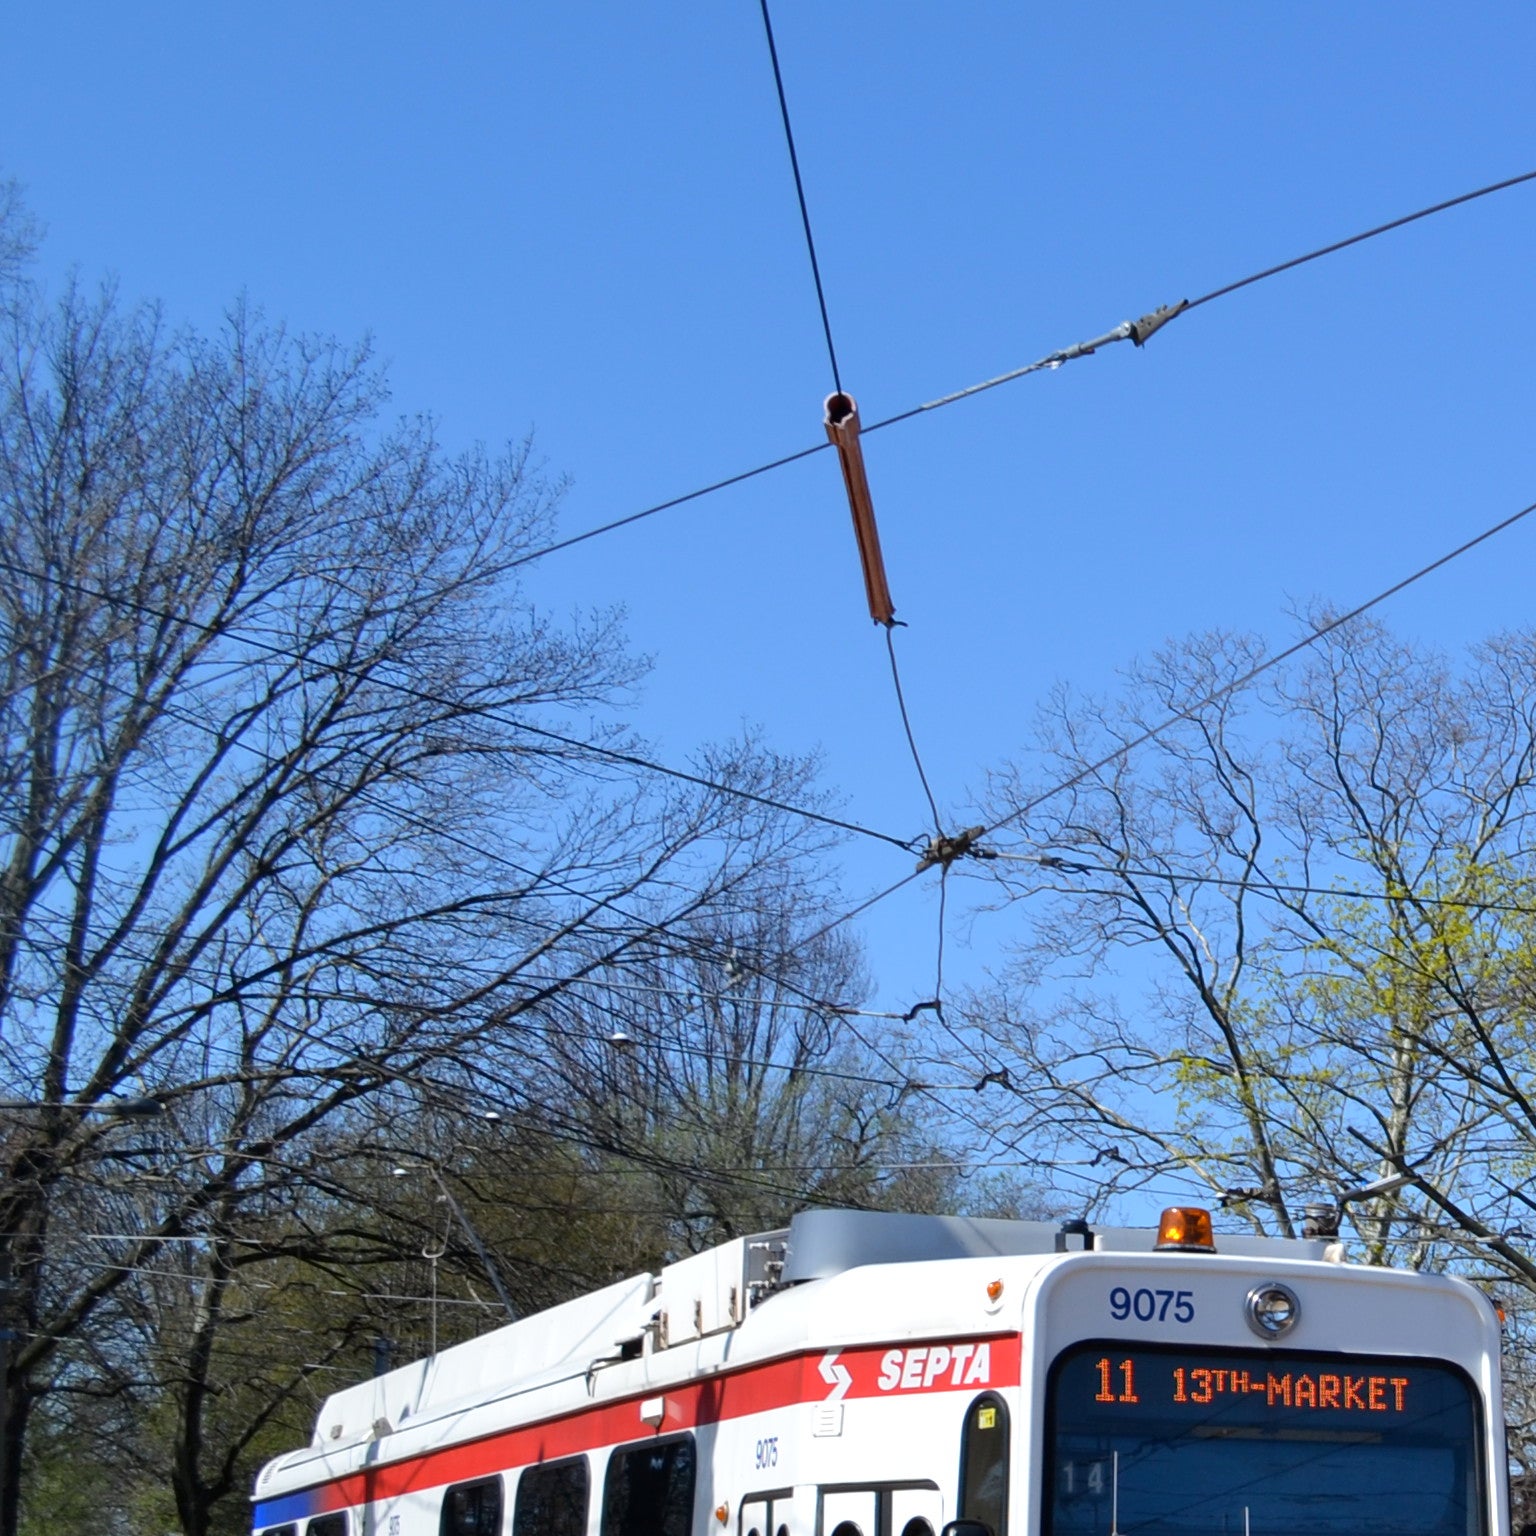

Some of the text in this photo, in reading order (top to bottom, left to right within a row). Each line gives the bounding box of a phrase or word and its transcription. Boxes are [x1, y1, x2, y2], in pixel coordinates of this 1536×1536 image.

[1110, 1287, 1196, 1323] 9075
[878, 1344, 990, 1391] SEPTA
[1096, 1359, 1140, 1403] 11
[756, 1438, 779, 1469] 9075
